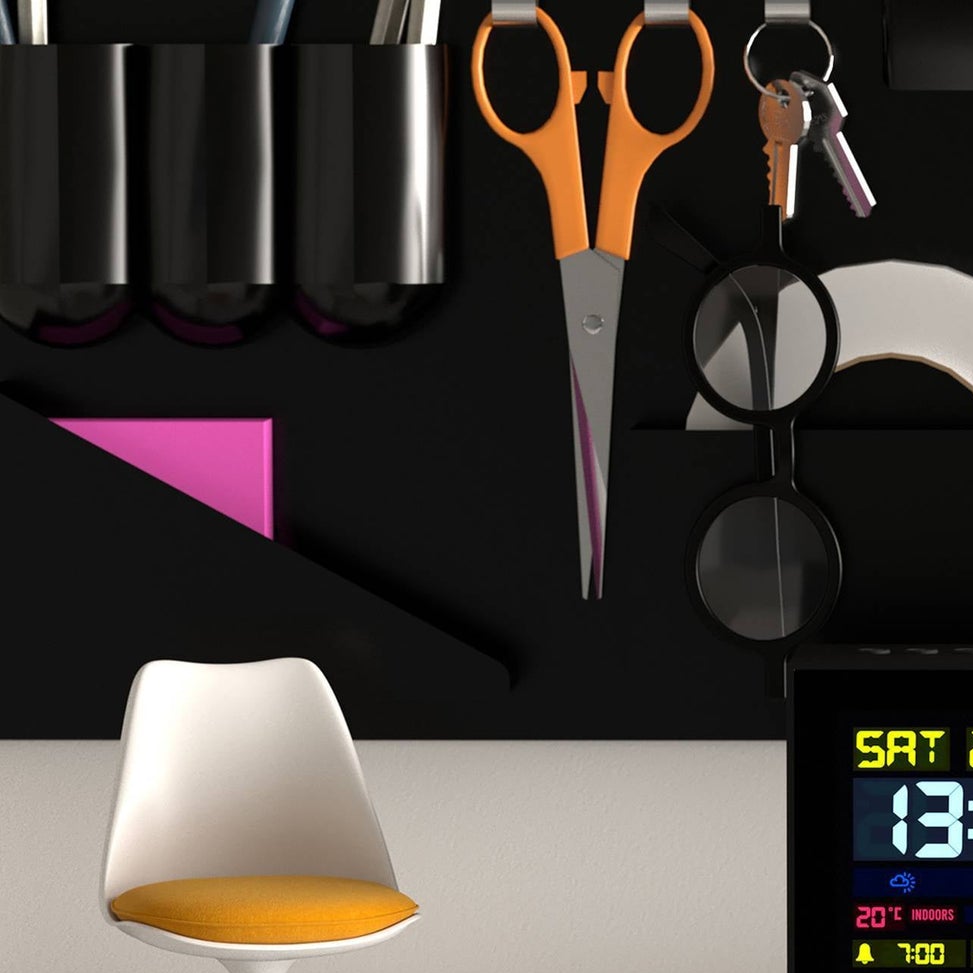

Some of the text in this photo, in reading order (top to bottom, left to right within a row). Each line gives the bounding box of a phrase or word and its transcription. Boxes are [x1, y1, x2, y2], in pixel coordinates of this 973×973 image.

[855, 730, 946, 769] SAT
[911, 908, 955, 921] INDOORS
[897, 942, 945, 965] 7:00
